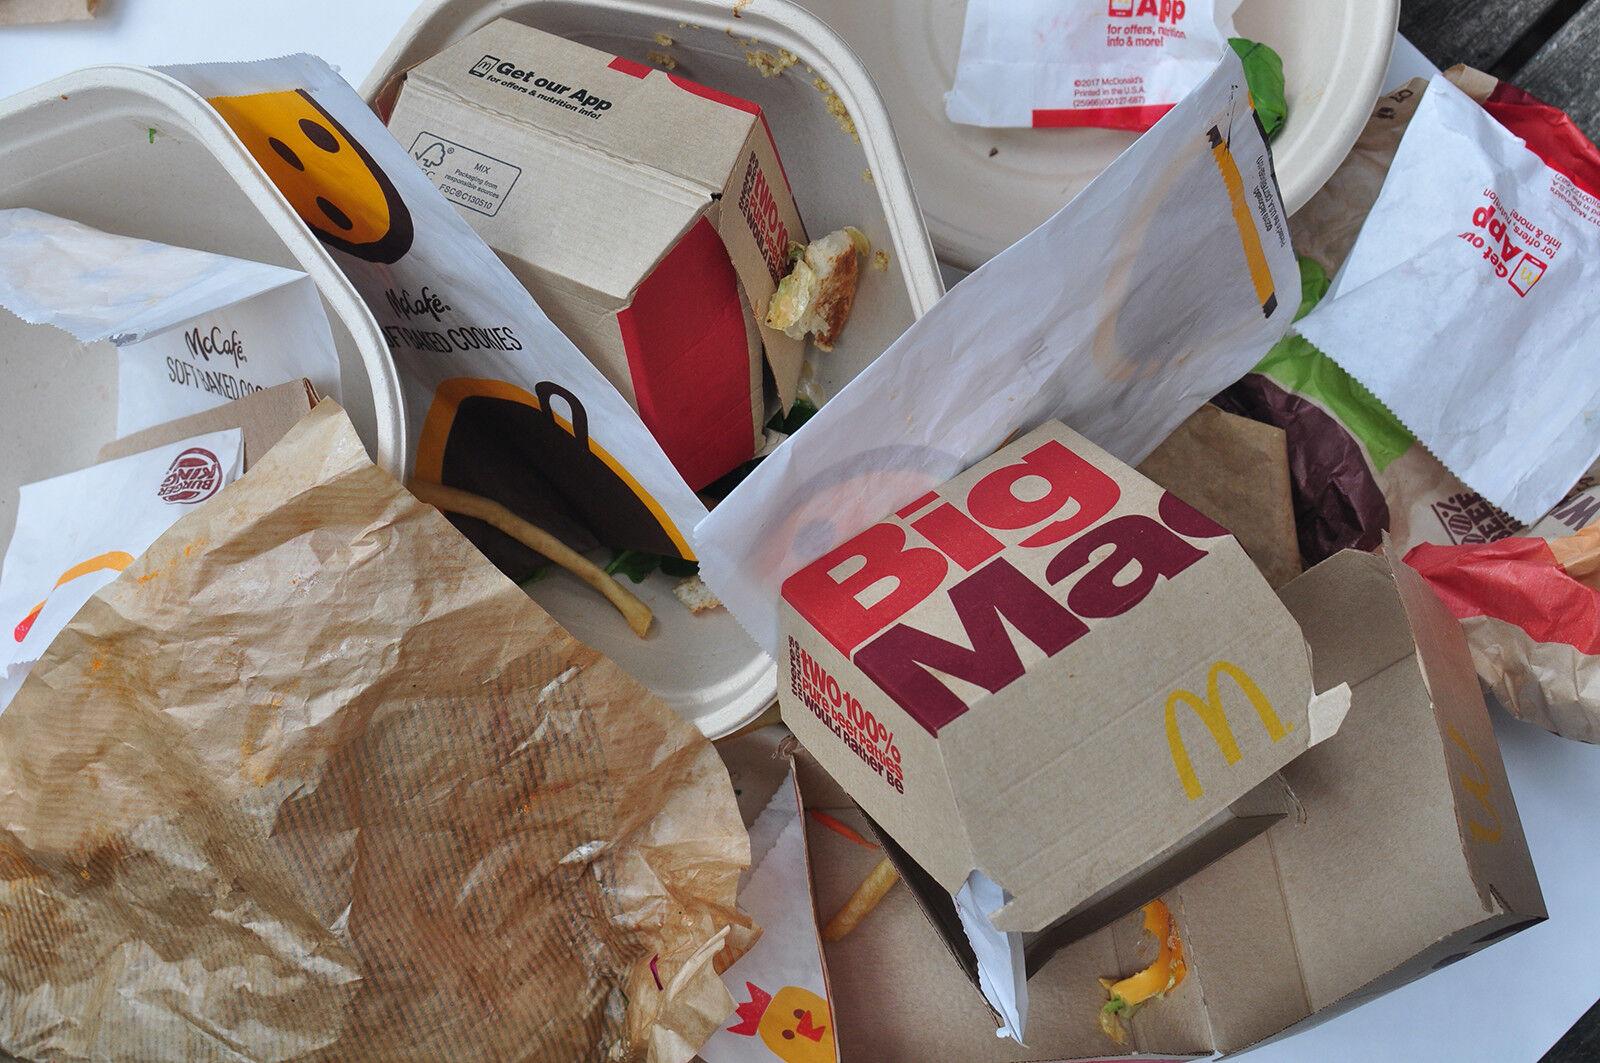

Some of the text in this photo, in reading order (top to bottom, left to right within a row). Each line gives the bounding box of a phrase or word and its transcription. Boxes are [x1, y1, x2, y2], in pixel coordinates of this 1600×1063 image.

[1136, 0, 1185, 24] App
[1107, 25, 1122, 34] for
[1124, 24, 1155, 35] offers,
[1107, 36, 1163, 47] info & more!
[486, 74, 602, 120] for offers & nutrition info!
[496, 62, 612, 111] Get our App
[1074, 88, 1100, 97] Printed
[1111, 86, 1123, 95] the
[455, 169, 498, 190] Packaging from
[474, 163, 491, 174] MIX
[444, 174, 477, 191] responsible
[477, 187, 500, 199] sources
[1550, 186, 1587, 219] McDonald's
[1472, 205, 1523, 262] App
[1510, 209, 1562, 251] info & more!
[1513, 222, 1541, 248] offers,
[1482, 246, 1508, 278] Get
[1541, 246, 1557, 259] for
[185, 326, 245, 369] McCafé
[447, 326, 523, 351] COOKIES
[166, 356, 199, 389] SOFT
[197, 368, 240, 401] BAKED
[157, 479, 215, 497] BURGER
[161, 464, 217, 487] KING
[781, 439, 1121, 660] Big
[843, 691, 902, 763] 100%
